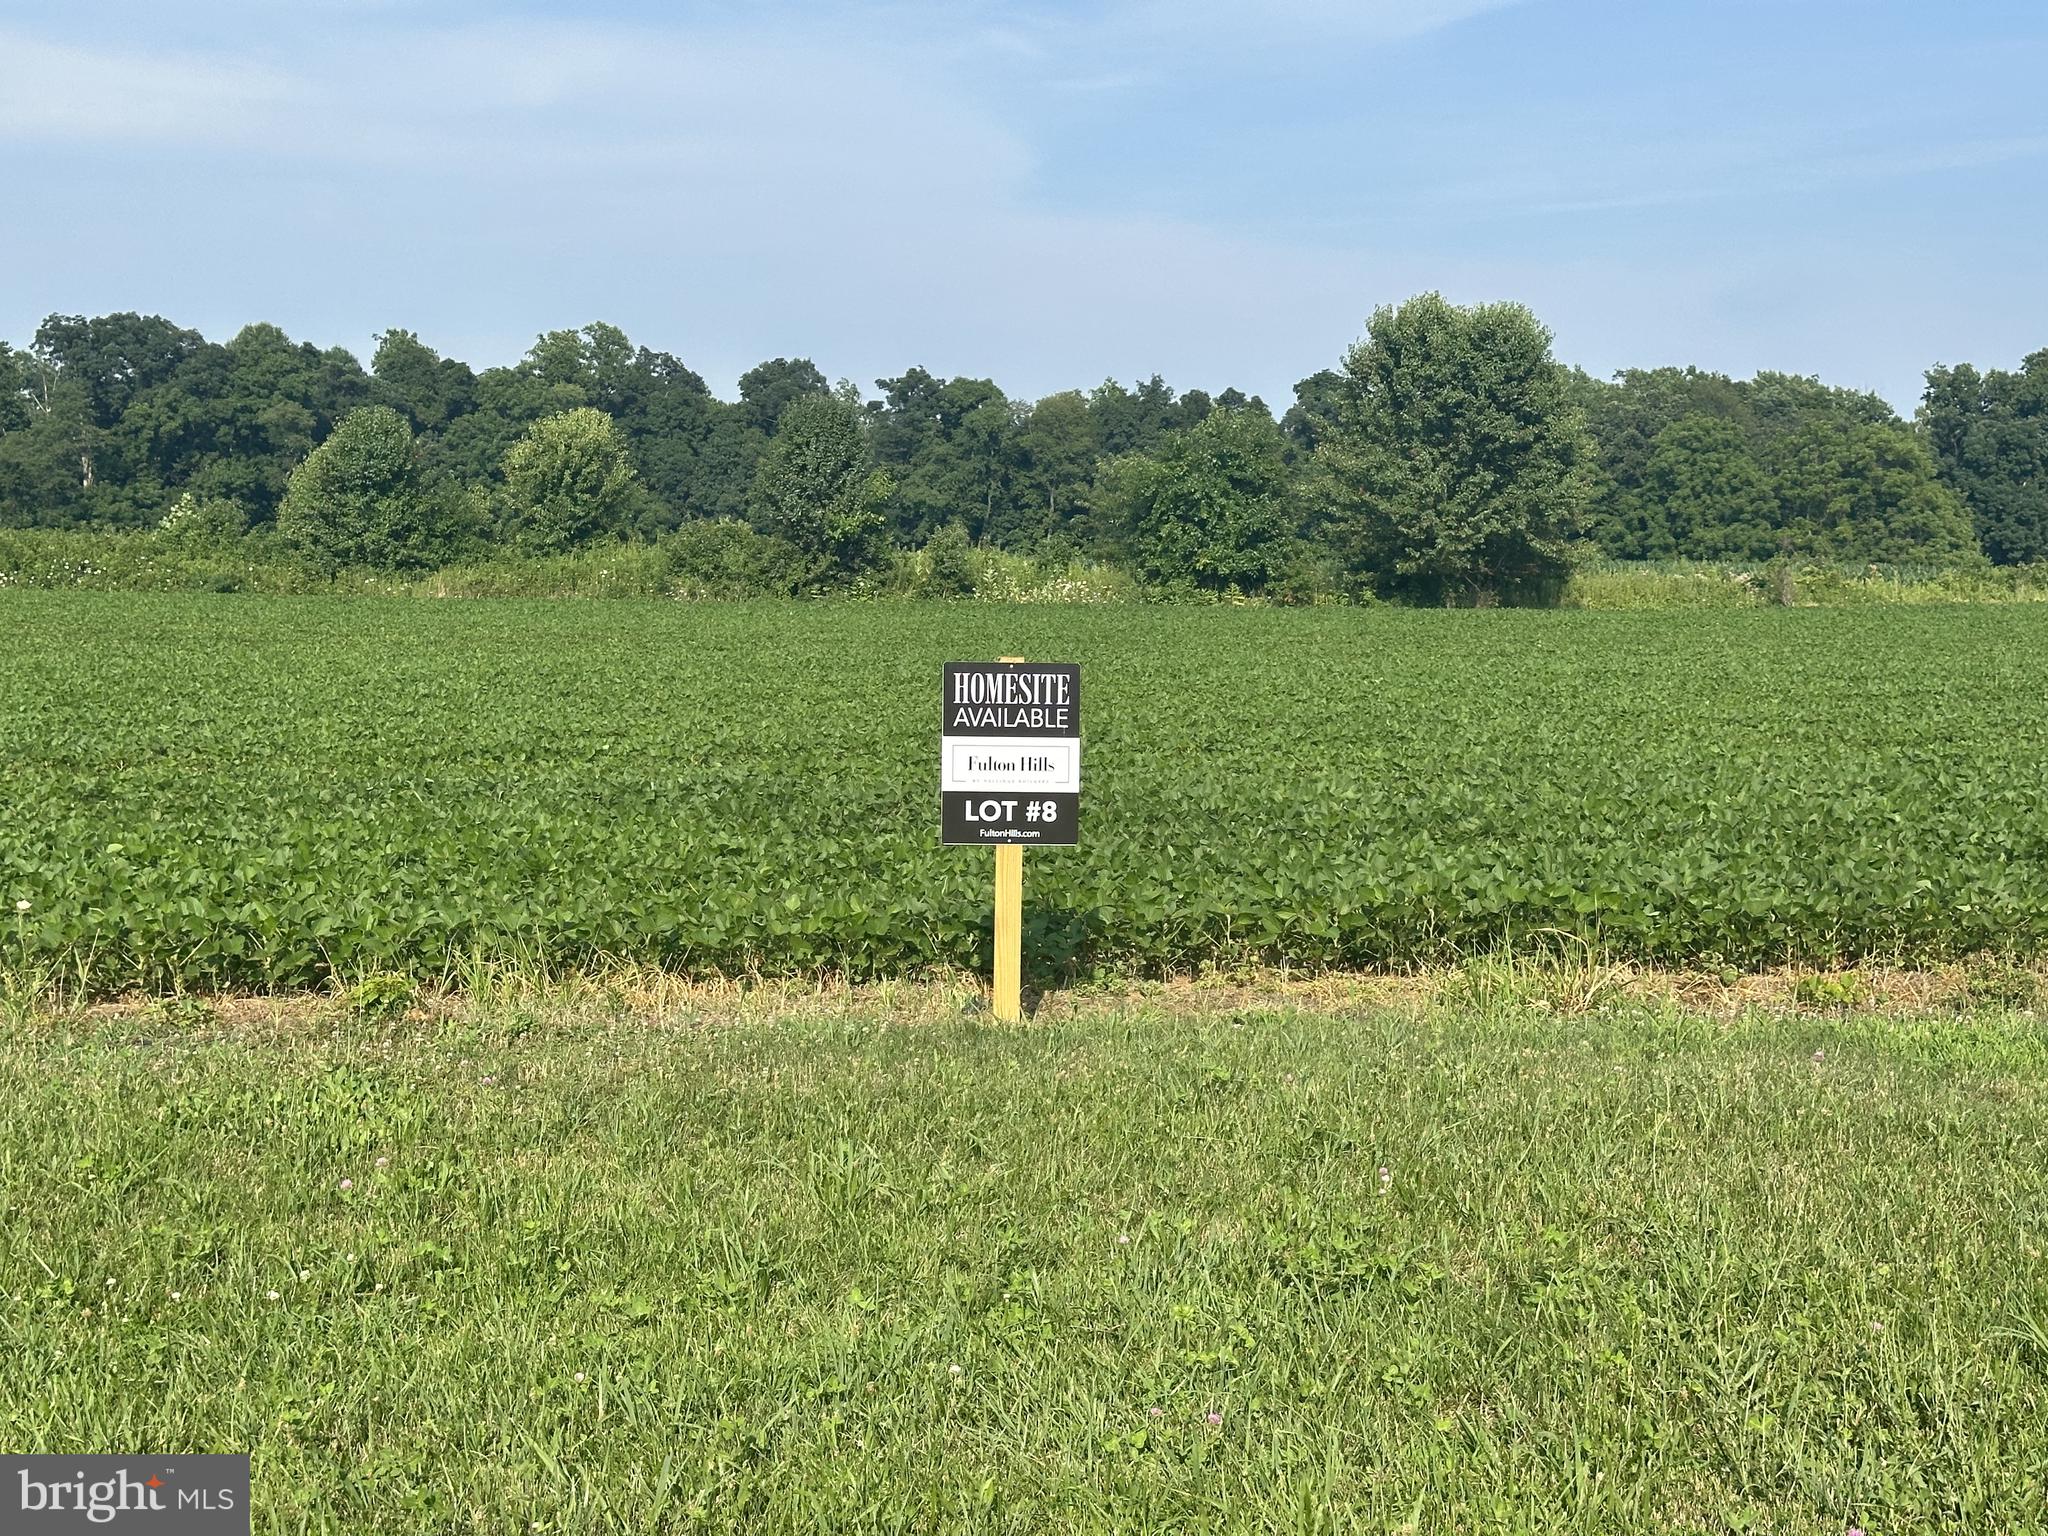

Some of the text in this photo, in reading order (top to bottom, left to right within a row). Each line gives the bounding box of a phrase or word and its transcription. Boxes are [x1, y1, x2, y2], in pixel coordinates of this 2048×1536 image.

[953, 672, 1070, 705] HOMESITE
[953, 707, 1069, 728] AVAILABLE
[968, 756, 1055, 772] Fulton Hills
[965, 800, 1058, 823] LOT #8
[979, 829, 1041, 838] FultonHills.com
